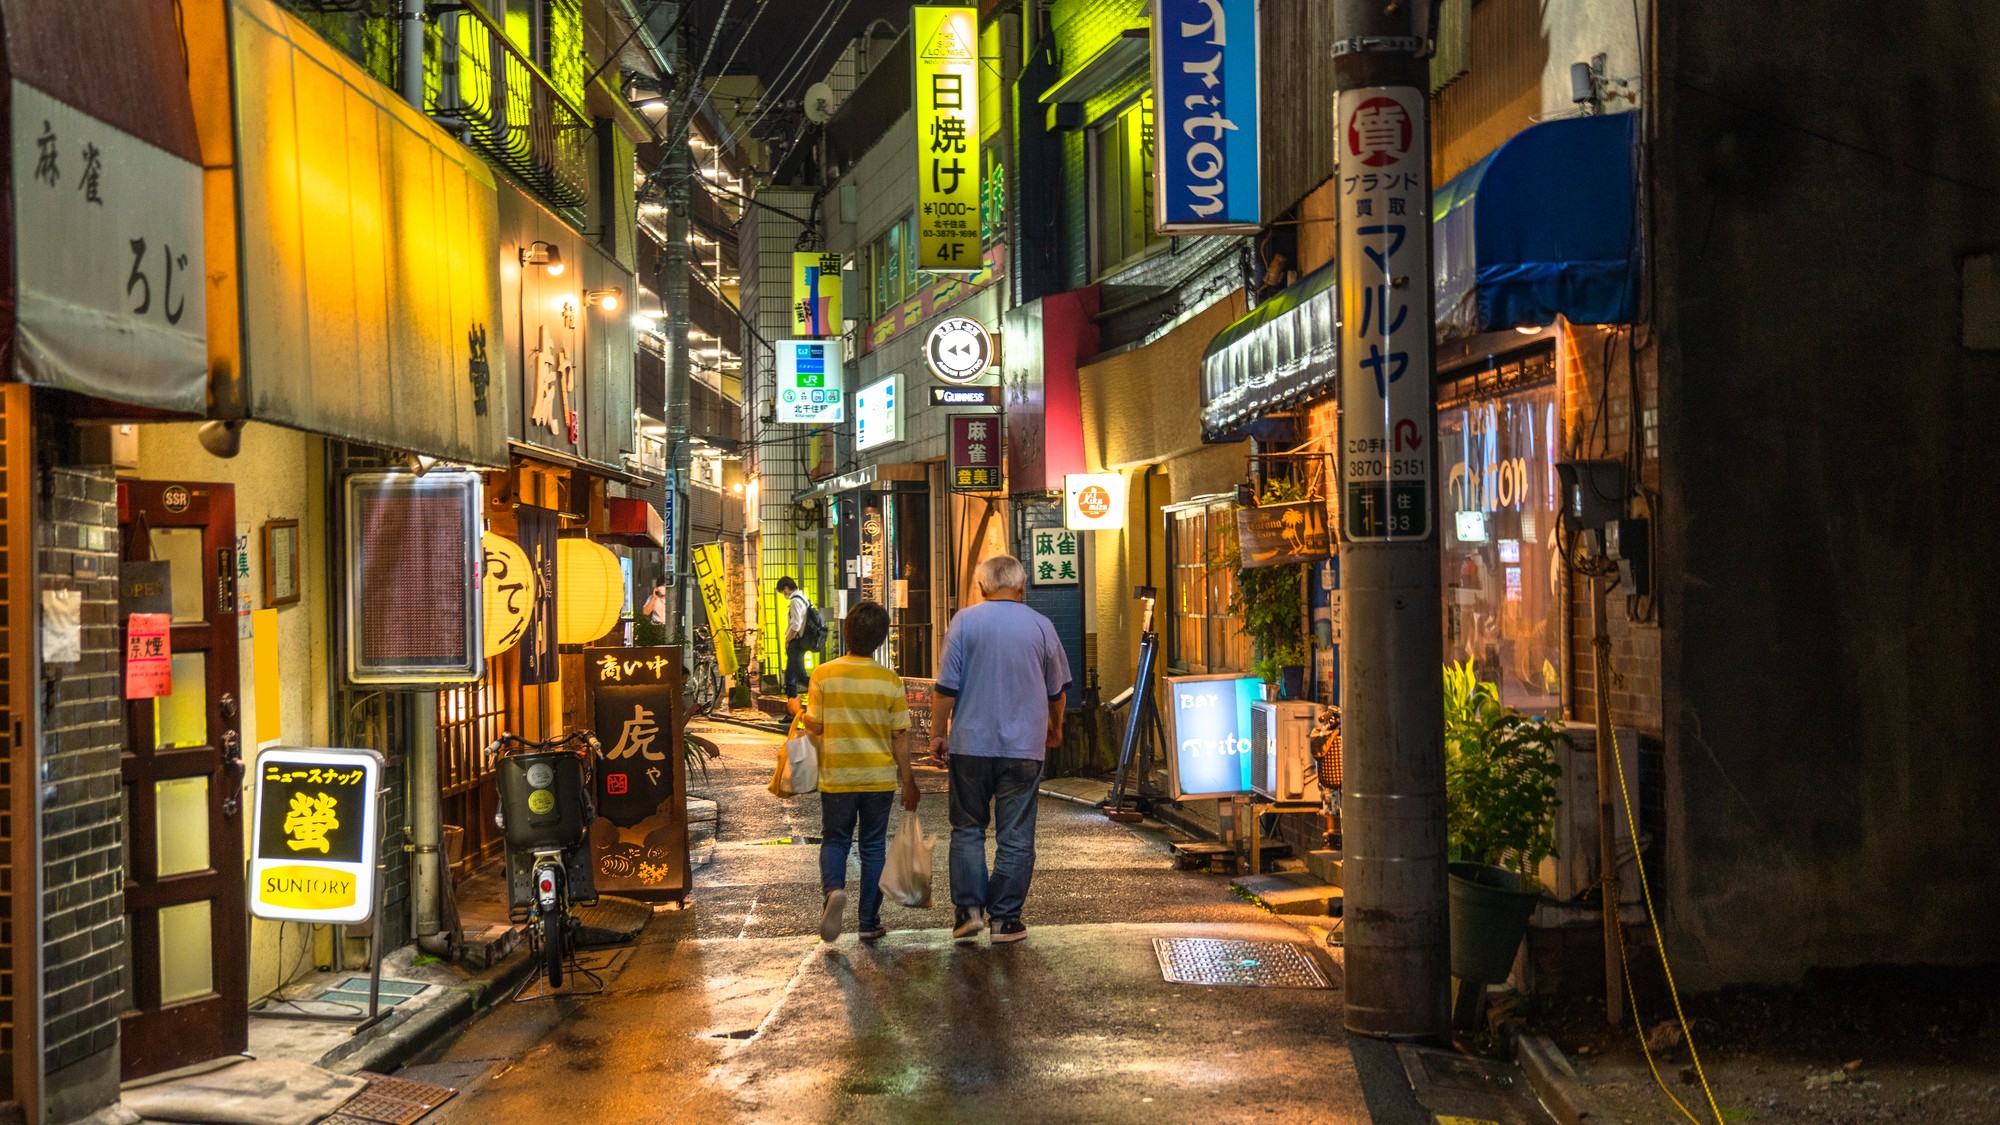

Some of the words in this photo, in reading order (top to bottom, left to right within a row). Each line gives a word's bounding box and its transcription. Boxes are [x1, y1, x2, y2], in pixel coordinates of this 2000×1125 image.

[930, 74, 966, 195] 日焼け
[1352, 104, 1408, 163] 質
[34, 119, 103, 207] 麻雀
[1344, 172, 1418, 195] ブランド
[1356, 197, 1406, 217] 買取
[933, 220, 967, 229] 北千住店
[936, 243, 965, 261] 4F
[126, 236, 190, 326] ろじ
[1356, 224, 1409, 399] マルヤ
[803, 375, 818, 384] JR
[944, 391, 985, 402] GUINNESS
[967, 421, 987, 464] 麻雀
[957, 468, 989, 485] 登美
[1349, 460, 1425, 476] 3870-5151
[165, 492, 187, 505] SSR
[1360, 494, 1412, 509] 千住
[1248, 521, 1283, 532] Corona
[1035, 531, 1076, 556] 麻雀
[1037, 560, 1077, 580] 登美
[483, 547, 531, 645] おでん
[130, 635, 164, 658] 禁煙
[266, 767, 364, 785] ニュースナック
[284, 792, 340, 854] 螢
[266, 877, 350, 895] SUNTORY
